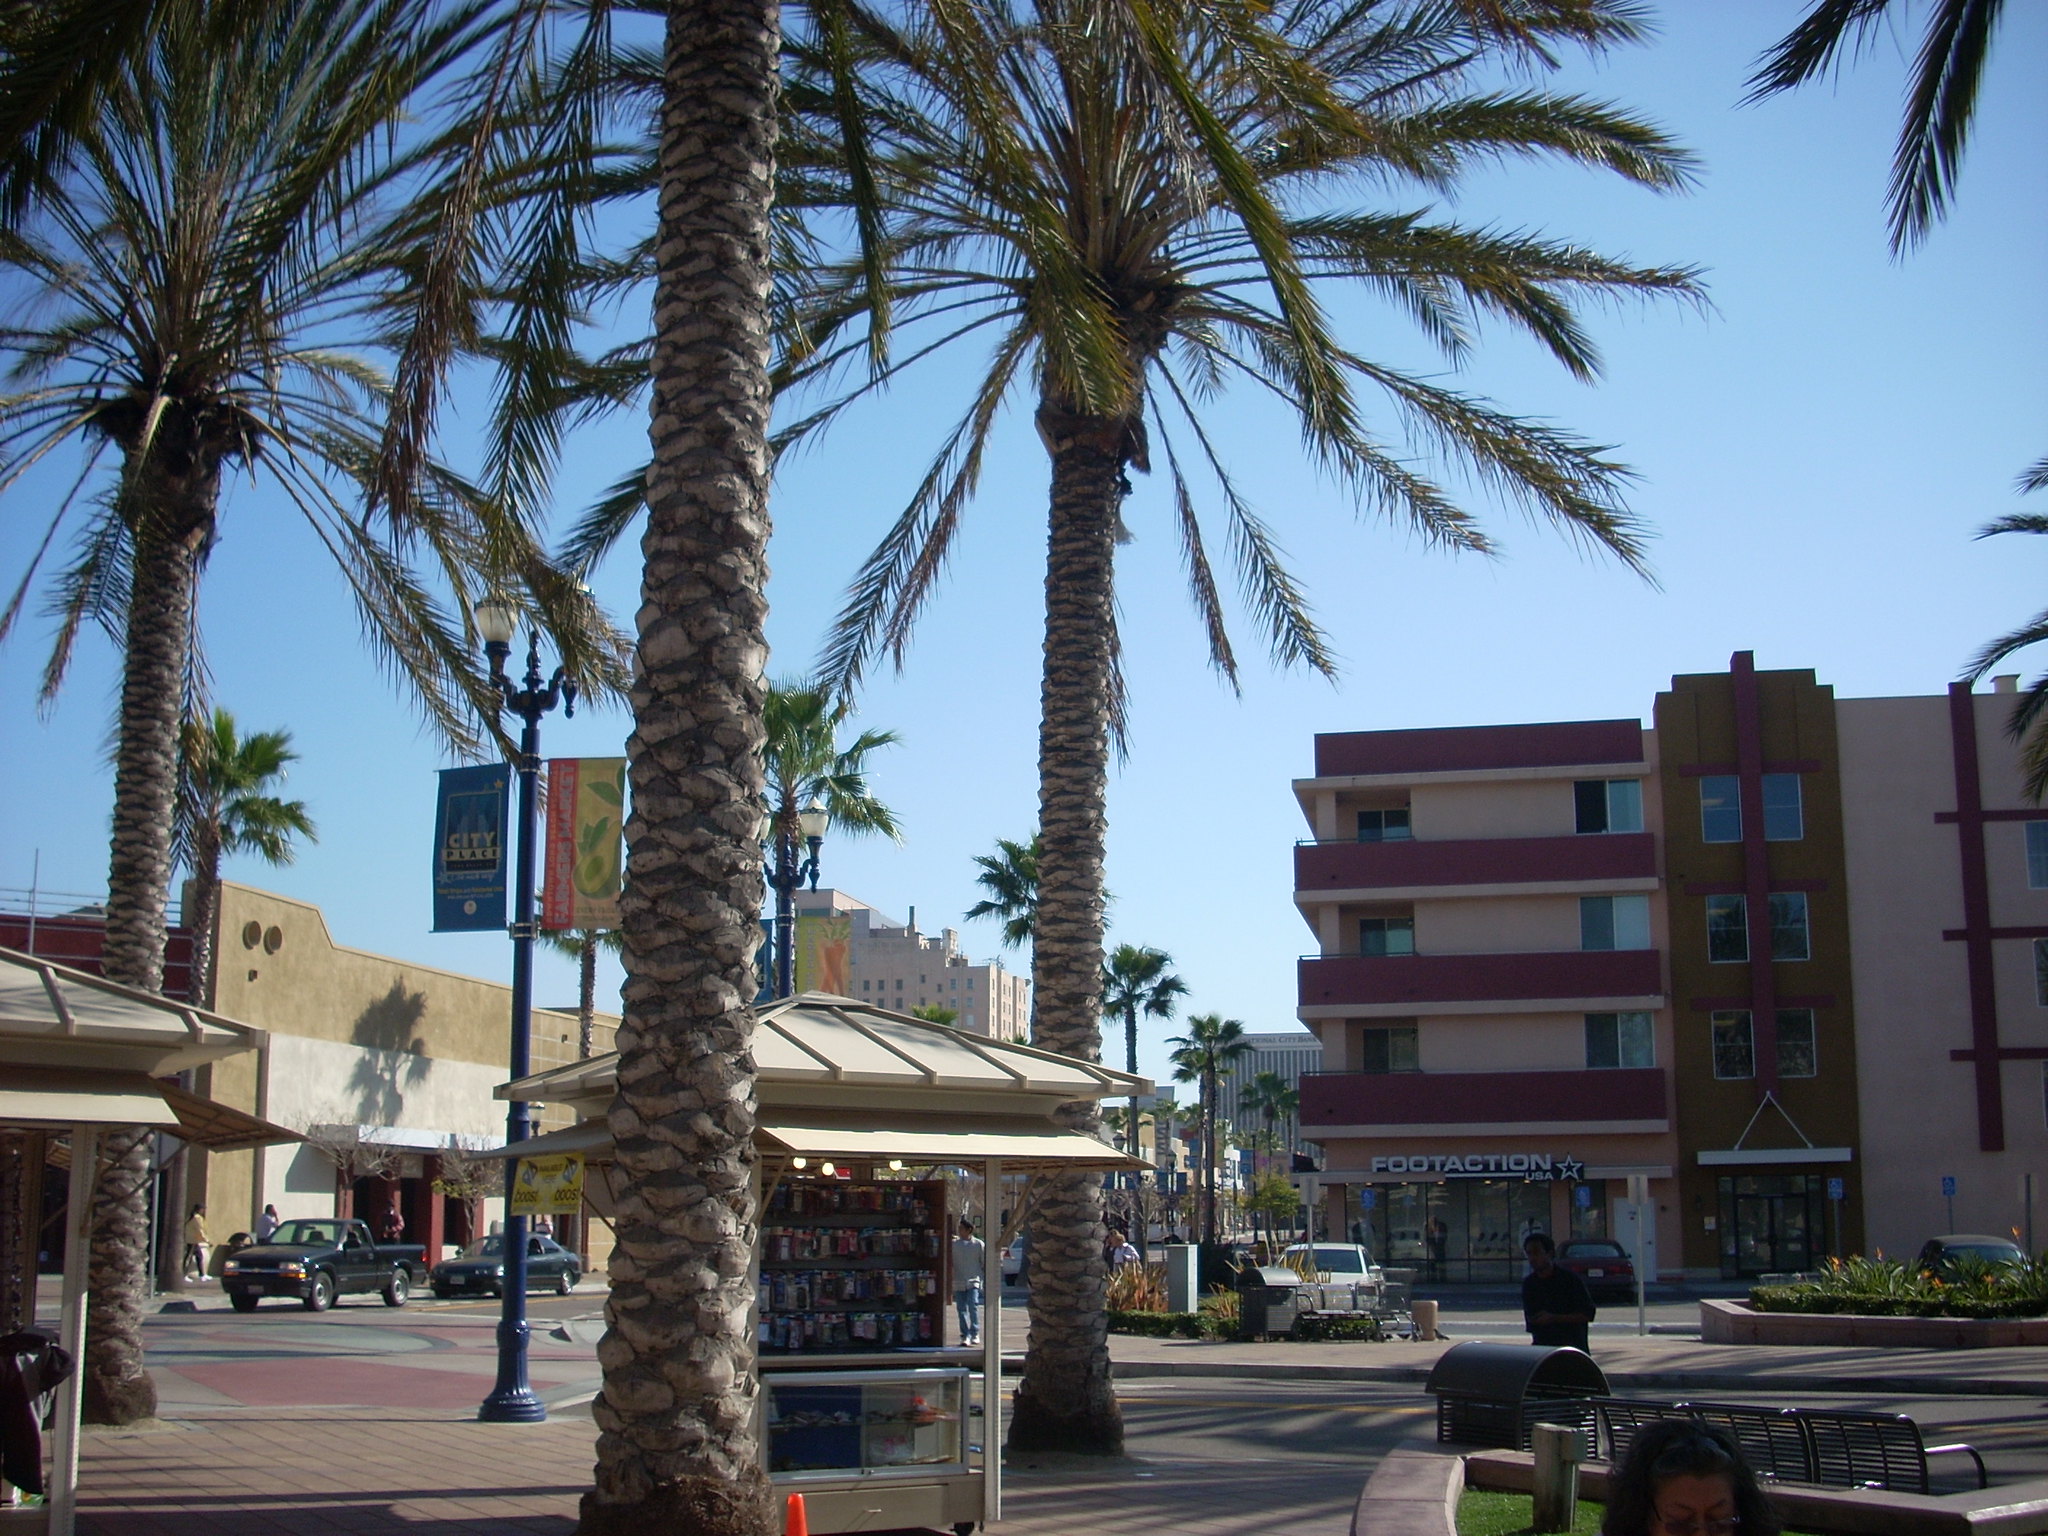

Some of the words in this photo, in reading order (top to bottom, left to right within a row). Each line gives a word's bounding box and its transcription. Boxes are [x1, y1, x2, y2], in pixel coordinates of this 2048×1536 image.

[557, 764, 575, 837] MARKET
[448, 832, 497, 849] CITY
[446, 848, 498, 859] PLACE
[554, 841, 571, 923] FARMERS
[1371, 1154, 1551, 1172] FOOTACTION
[1525, 1171, 1554, 1181] USA
[515, 1189, 539, 1202] boost
[554, 1187, 580, 1201] boost
